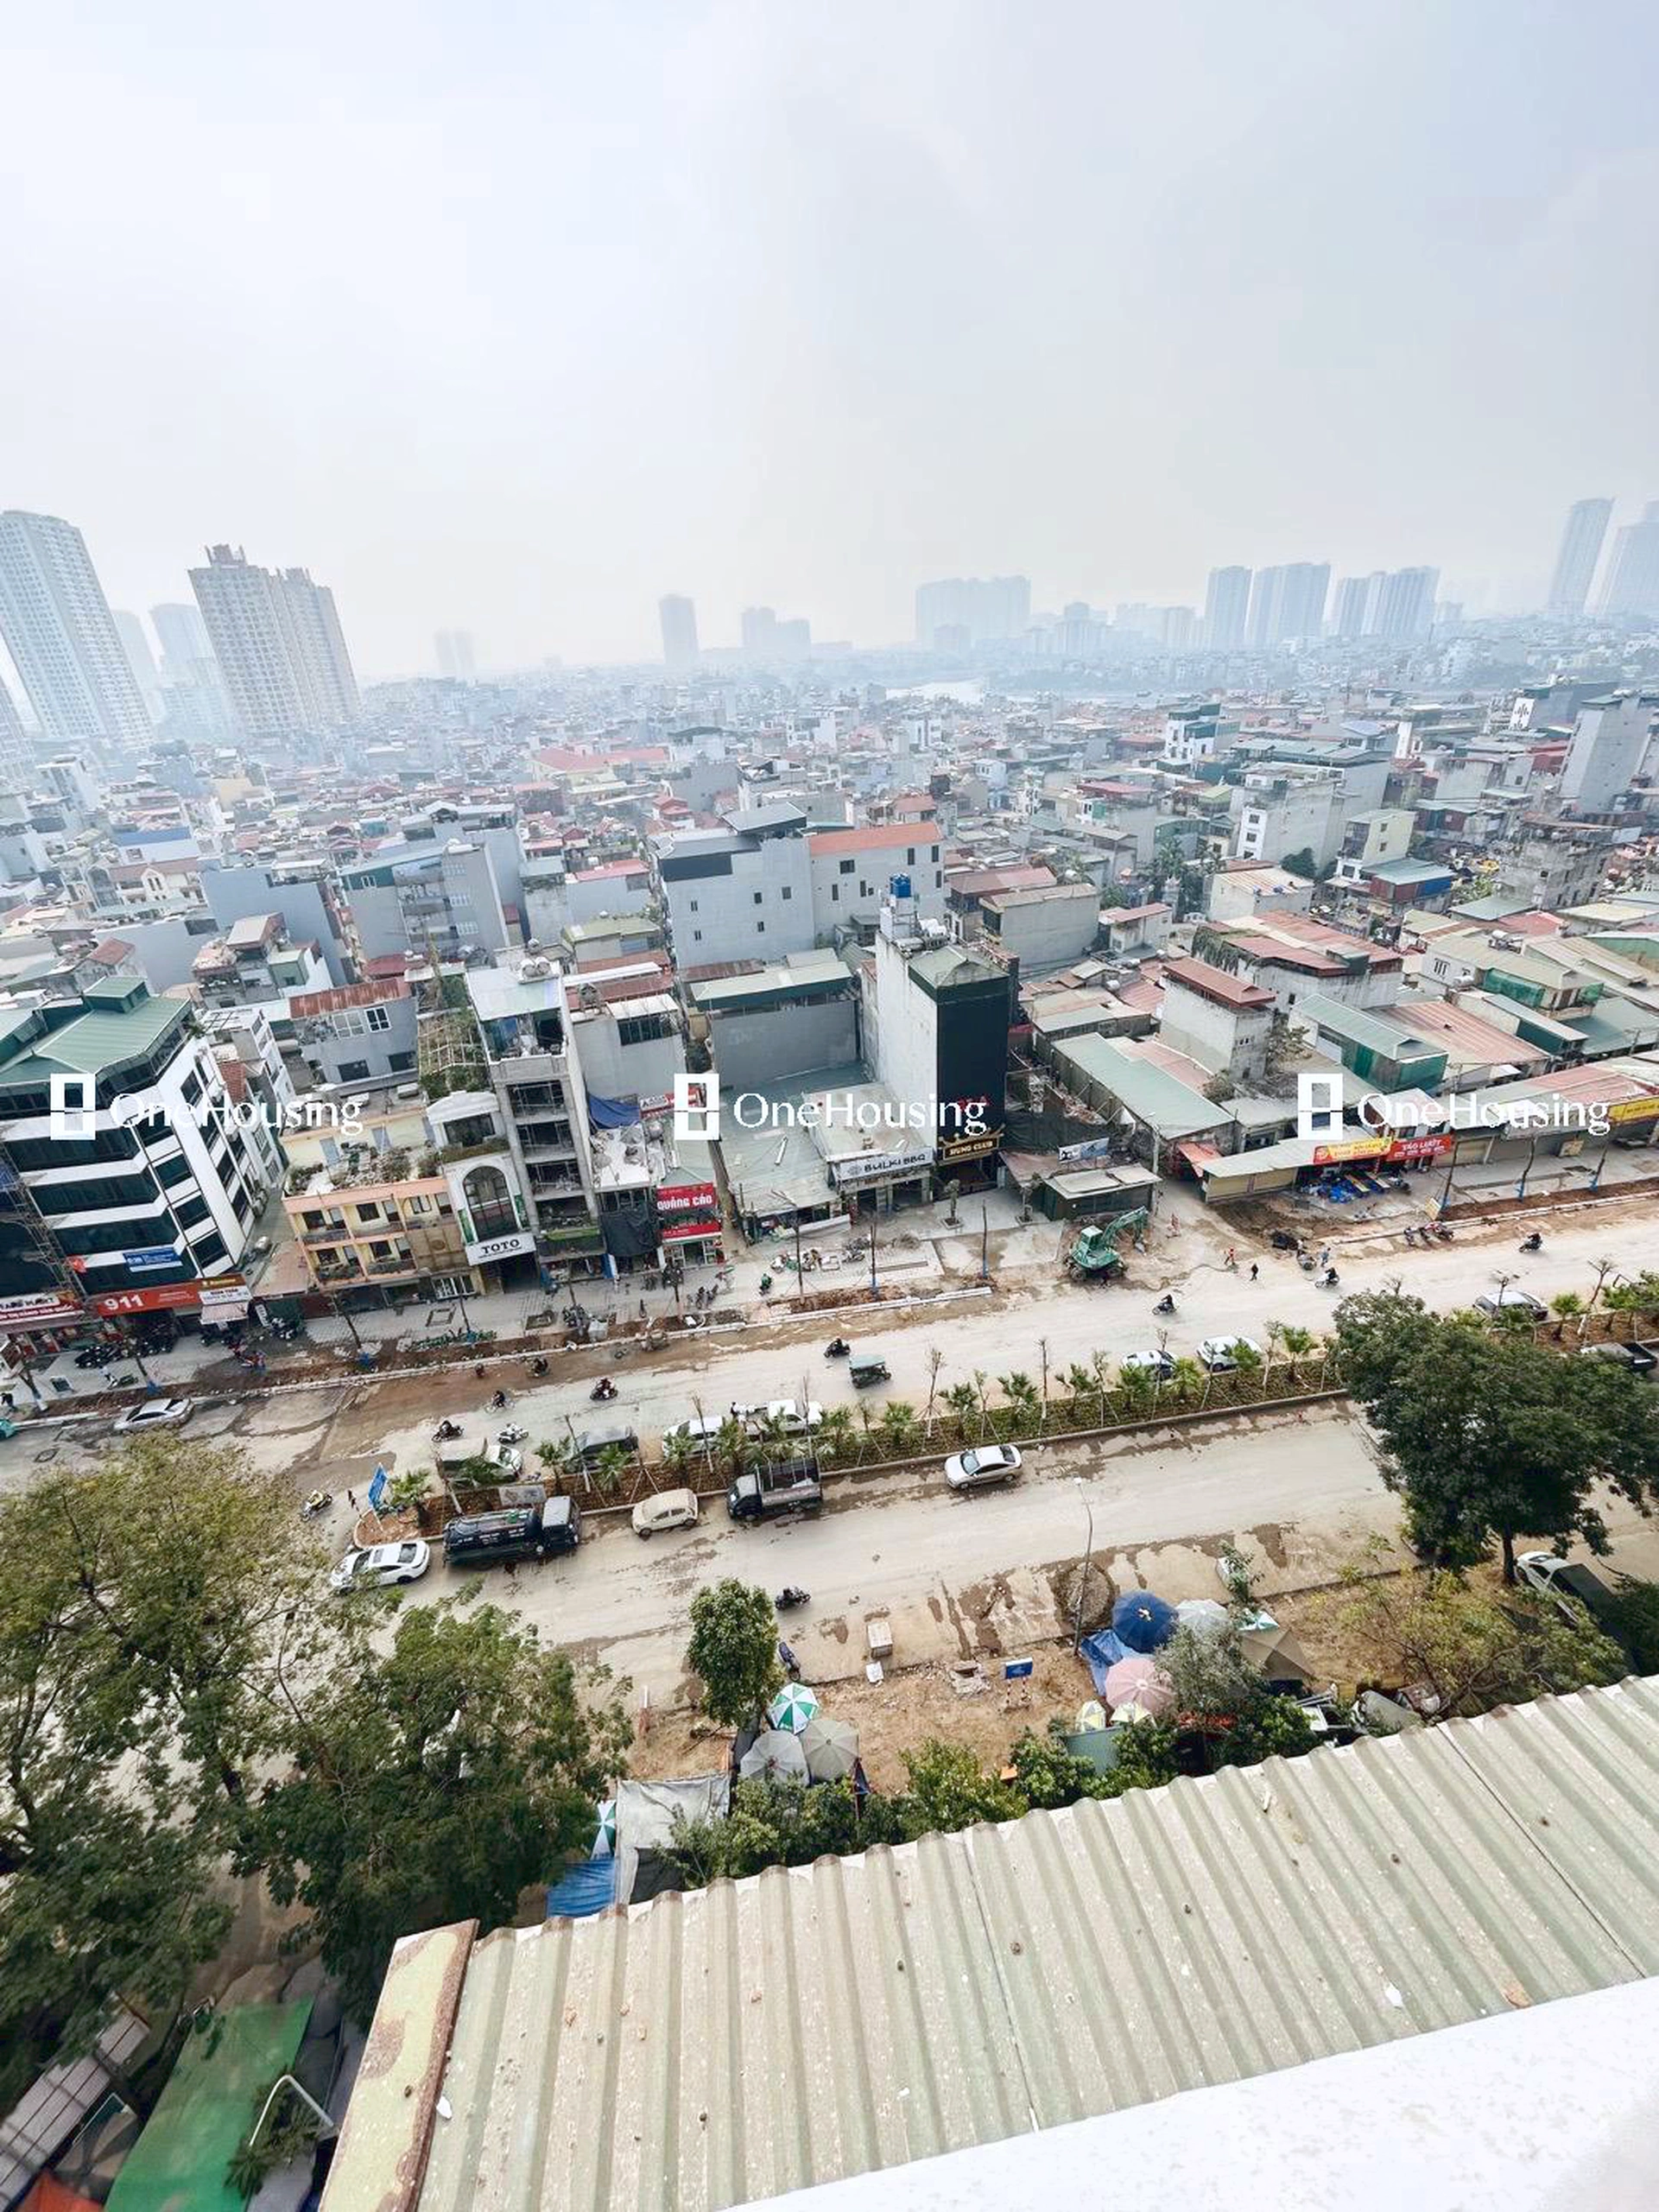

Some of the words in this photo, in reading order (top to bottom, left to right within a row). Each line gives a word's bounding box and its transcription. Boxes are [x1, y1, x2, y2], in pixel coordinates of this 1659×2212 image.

[692, 1192, 713, 1207] CÁO
[481, 1239, 521, 1254] TOTO
[104, 1294, 144, 1310] 911
